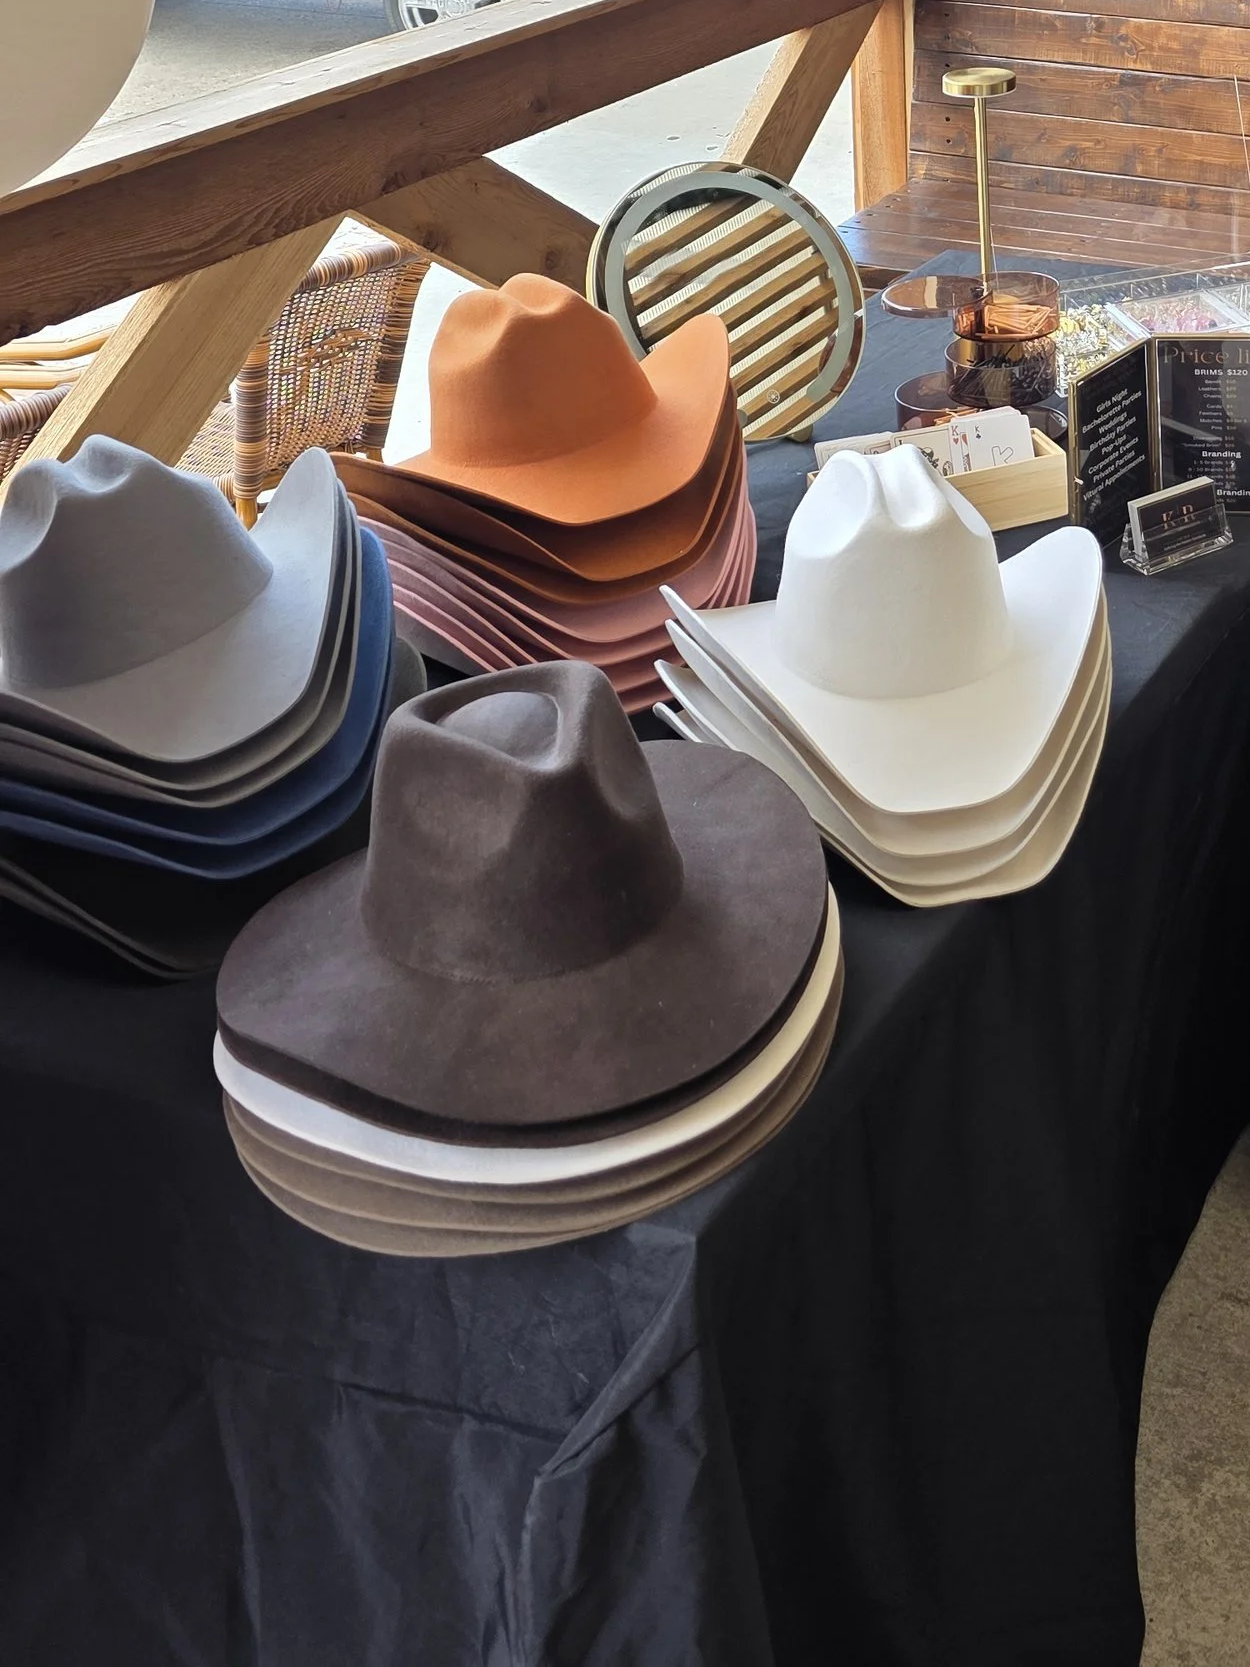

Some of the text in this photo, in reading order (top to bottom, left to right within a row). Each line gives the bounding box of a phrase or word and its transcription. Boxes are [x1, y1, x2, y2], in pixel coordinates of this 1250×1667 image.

[1163, 343, 1229, 364] Price
[1194, 368, 1248, 377] BRIMS $120
[1082, 390, 1142, 434] Bachelorette Parties
[1096, 388, 1128, 413] Girls Night
[951, 425, 959, 436] K
[974, 425, 980, 433] K
[1089, 416, 1137, 453] Birthday Parties
[1098, 411, 1128, 435] Weddings
[1088, 436, 1139, 475] Corporate Events
[1101, 434, 1127, 455] Pop-Ups
[1201, 450, 1242, 459] Branding
[1093, 450, 1135, 483] Private Parties
[1104, 453, 1146, 487] Appointments
